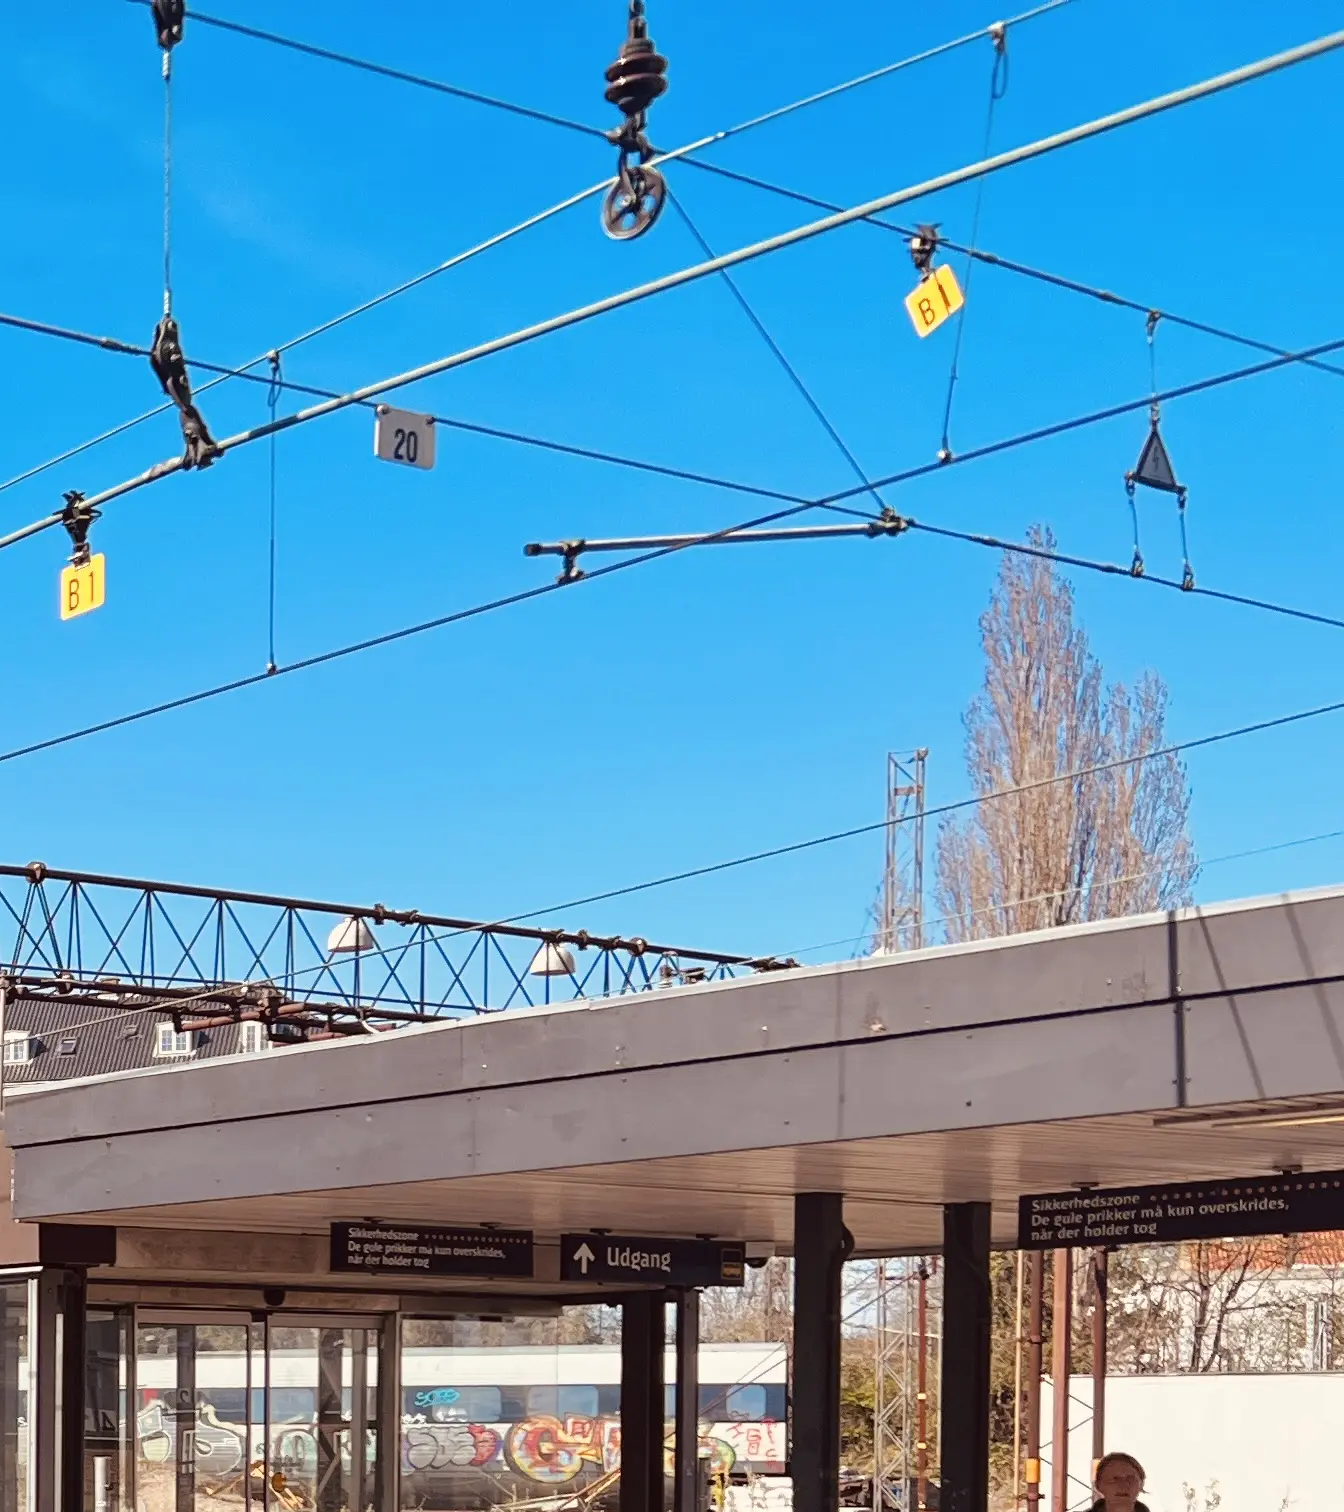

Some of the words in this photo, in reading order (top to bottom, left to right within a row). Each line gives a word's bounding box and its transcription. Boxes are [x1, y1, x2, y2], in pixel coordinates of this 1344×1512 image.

[917, 283, 952, 328] B1
[393, 427, 419, 464] 20
[68, 570, 95, 612] B1
[1031, 1194, 1141, 1213] Sikkerhedszone
[1031, 1214, 1051, 1227] De
[1053, 1212, 1084, 1227] gule
[1087, 1209, 1137, 1225] prikker
[1140, 1204, 1163, 1219] må
[1167, 1203, 1195, 1217] kun
[348, 1227, 420, 1242] Sikkerhedszone
[1031, 1227, 1054, 1241] når
[1057, 1226, 1081, 1240] der
[1084, 1223, 1130, 1238] holder
[1133, 1222, 1158, 1236] tog
[348, 1240, 362, 1252] De
[364, 1255, 381, 1266] der
[382, 1256, 412, 1267] holder
[413, 1258, 430, 1269] tog
[606, 1246, 672, 1273] Udgang
